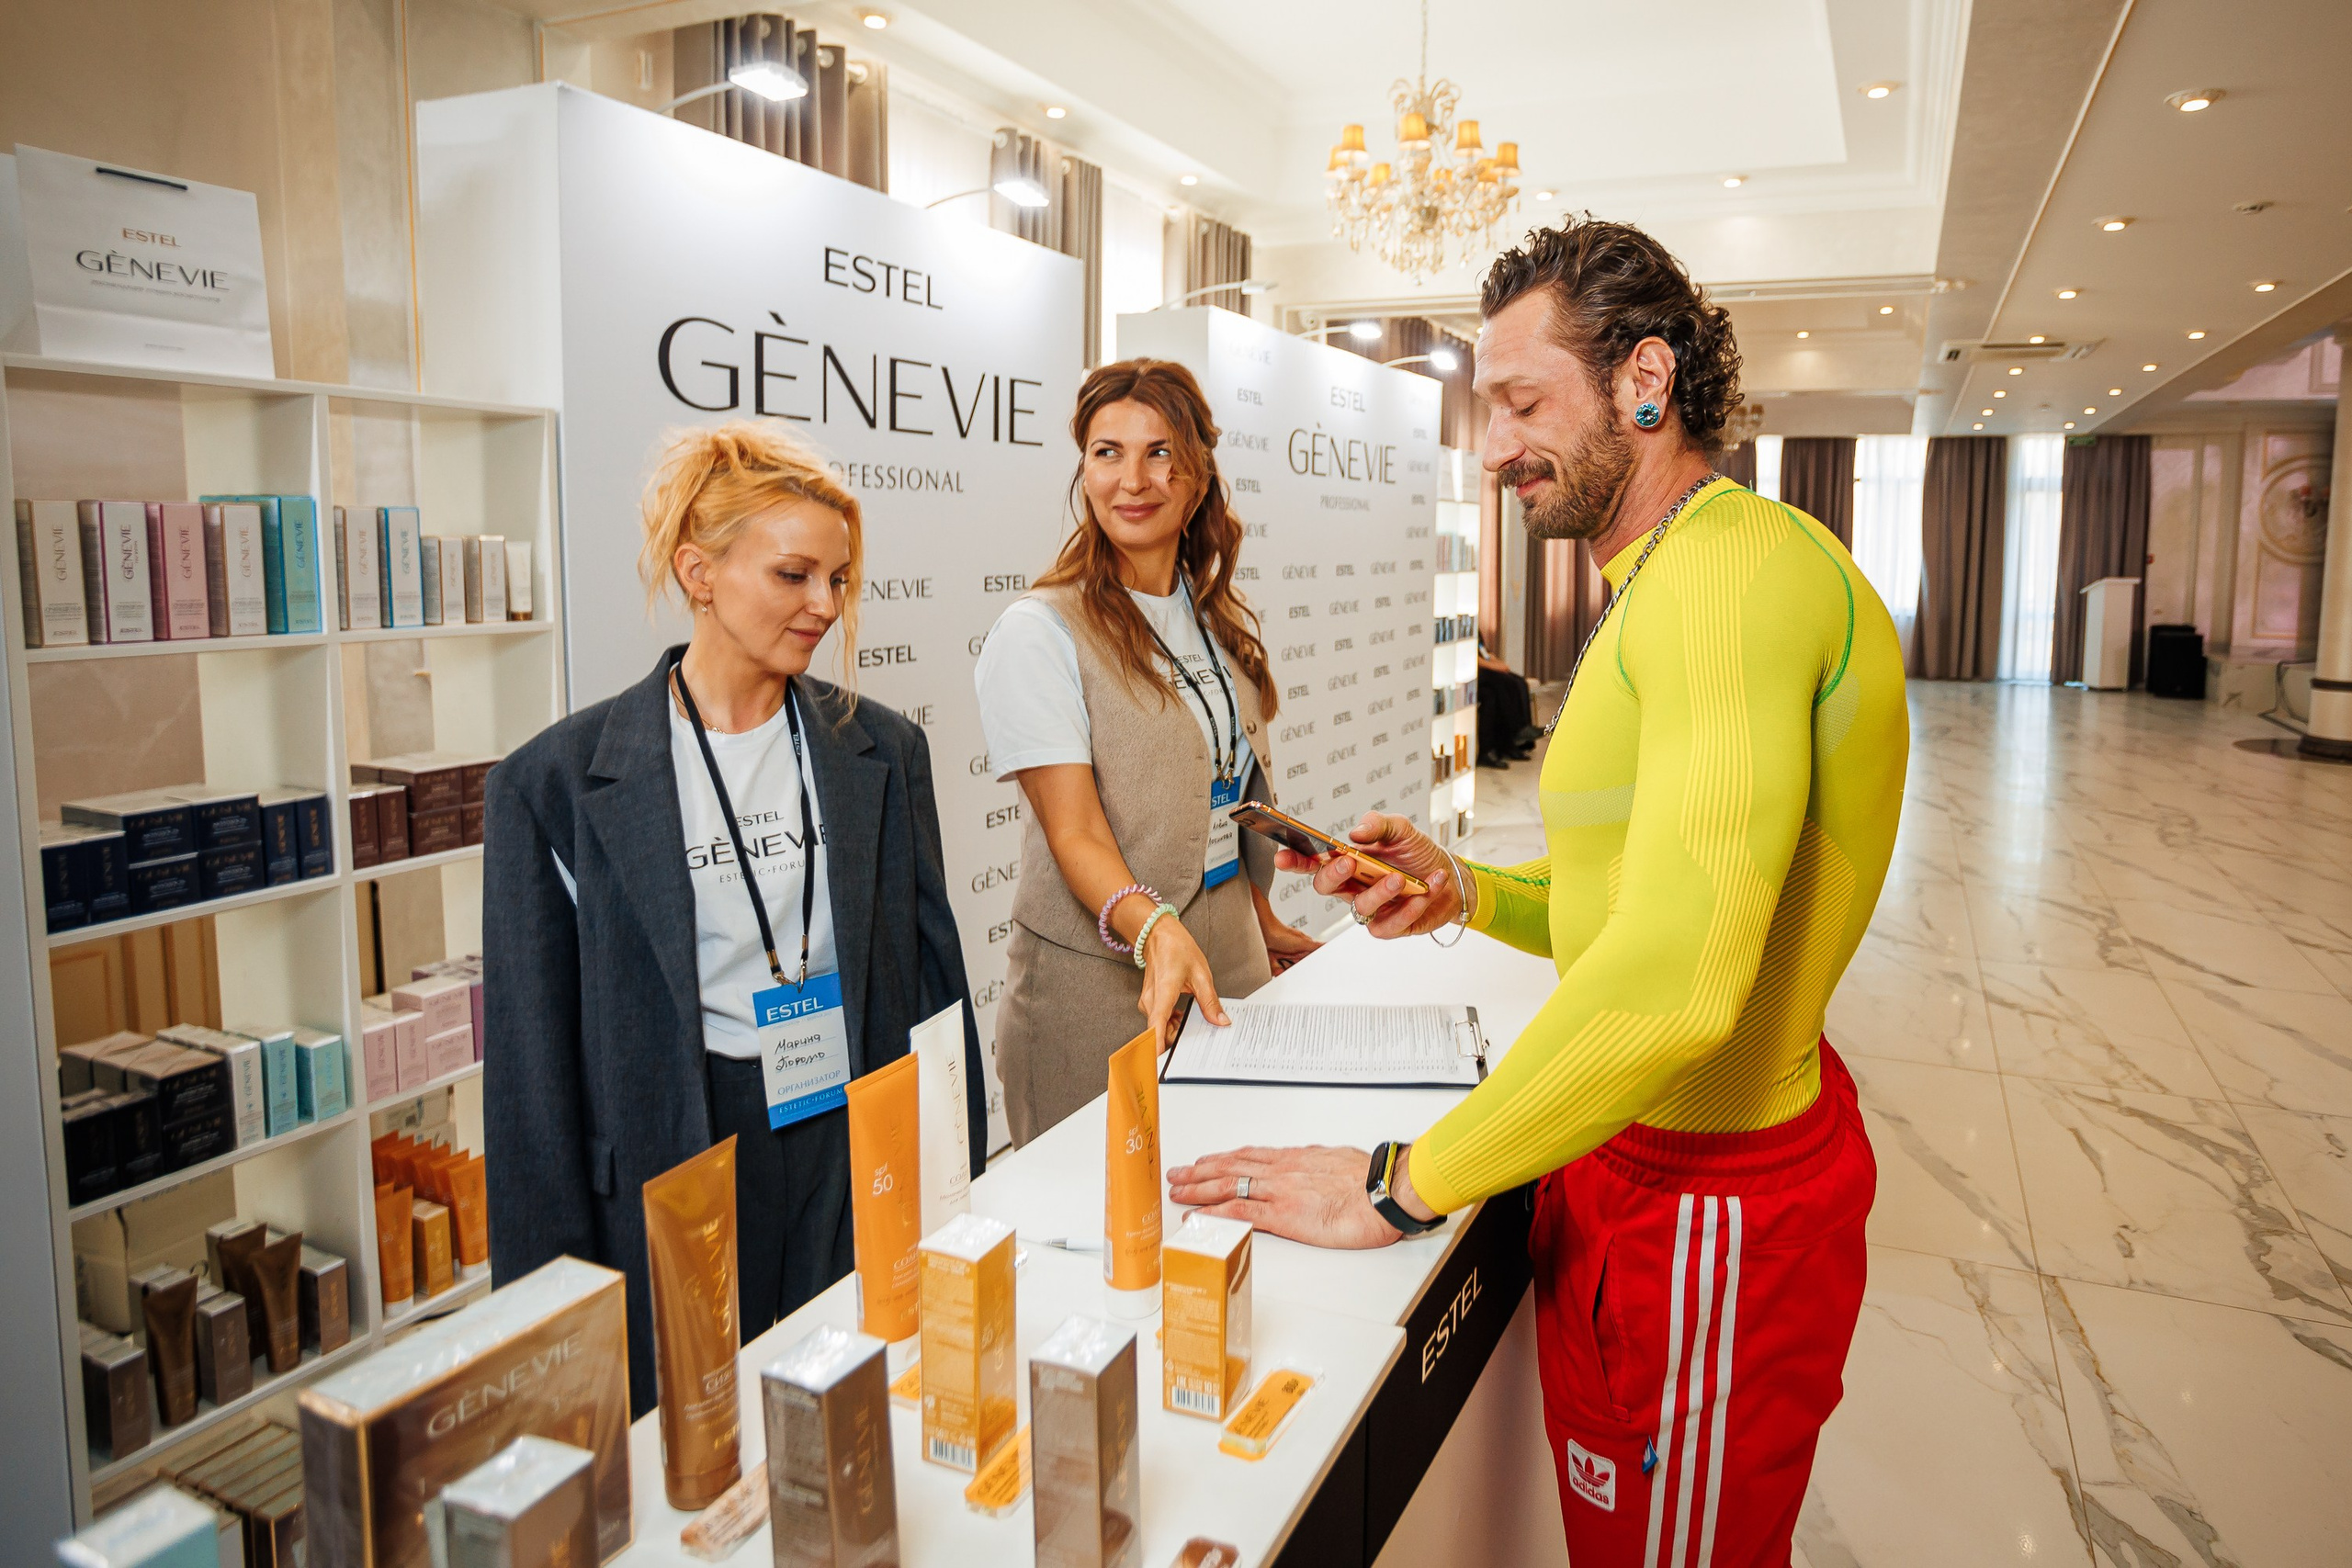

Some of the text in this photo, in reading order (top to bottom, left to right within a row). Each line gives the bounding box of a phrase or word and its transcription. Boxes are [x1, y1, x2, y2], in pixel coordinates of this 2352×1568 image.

[121, 227, 182, 248] ESTEL
[75, 249, 231, 293] GÈNEVIE
[823, 246, 944, 310] ESTEL
[658, 310, 1044, 447] GÈNEVIE
[1237, 388, 1263, 406] ESTEL
[1331, 386, 1366, 413] ESTEL
[1288, 423, 1396, 484] GÈNEVIE
[829, 461, 964, 493] OFESSIONAL
[1236, 478, 1261, 493] ESTEL
[862, 577, 933, 602] NEVIE
[984, 574, 1030, 592] ESTEL
[1289, 605, 1311, 619] ESTEL
[859, 645, 917, 669] ESTEL
[1288, 684, 1309, 700] ESTEL
[1287, 762, 1308, 780] ESTEL
[1211, 793, 1231, 807] STEL
[736, 811, 785, 828] ESTEL
[986, 804, 1021, 829] ESTE
[971, 861, 1021, 895] GÈNE
[989, 919, 1012, 944] EST
[766, 997, 824, 1022] ESTEL
[774, 1032, 821, 1055] Марина
[777, 1070, 841, 1096] ОРГАНИЗАТОР
[1125, 1134, 1143, 1155] 30
[875, 1160, 888, 1178] spf
[872, 1174, 894, 1199] 50
[1421, 1266, 1482, 1384] ESTEL
[1572, 1475, 1610, 1505] adidas
